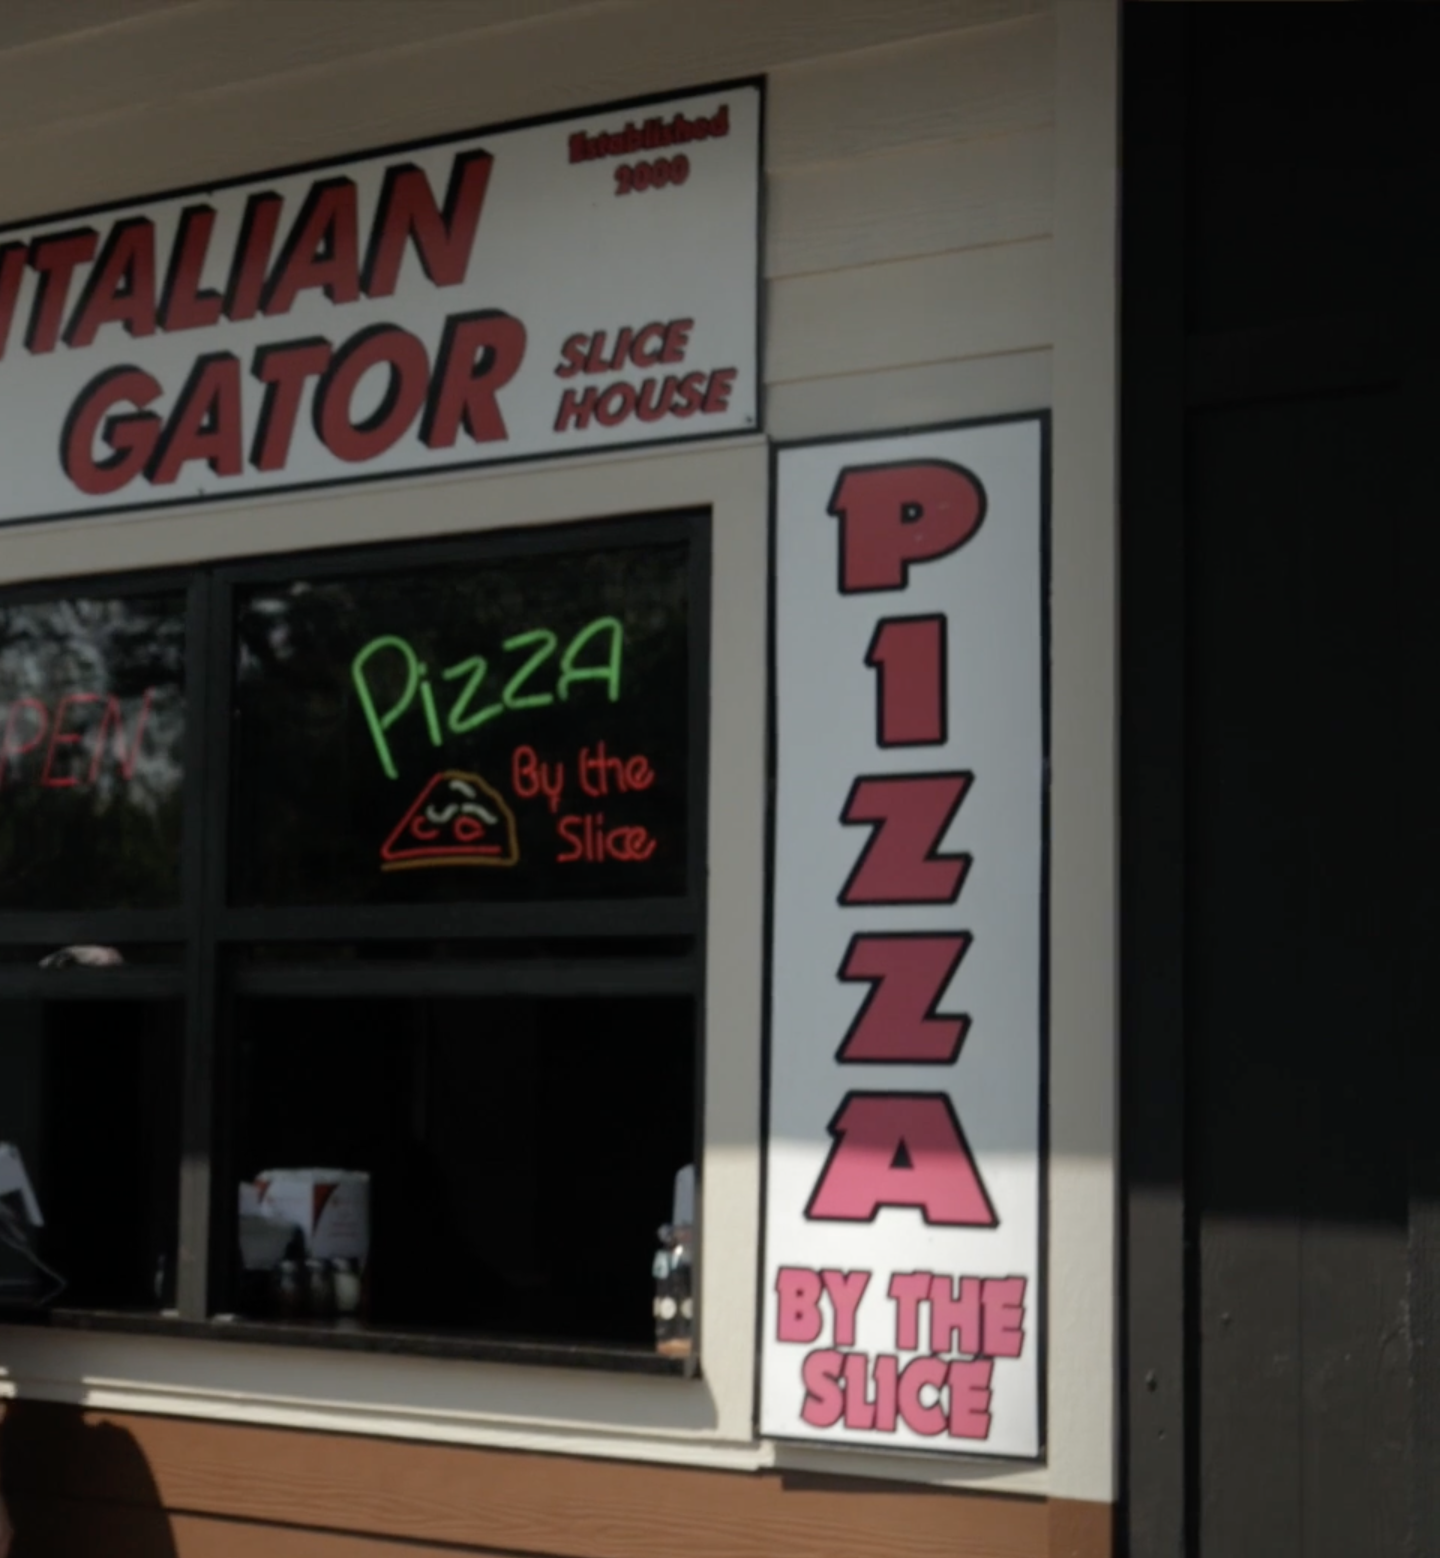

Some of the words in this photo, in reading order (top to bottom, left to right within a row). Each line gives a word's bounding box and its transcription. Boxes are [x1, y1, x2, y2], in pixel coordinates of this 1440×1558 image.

[567, 105, 731, 164] Established
[613, 153, 690, 195] 2000
[554, 318, 694, 379] SLICE
[59, 308, 526, 496] GATOR
[552, 367, 737, 434] HOUSE
[511, 744, 564, 813] By
[580, 742, 655, 796] the
[556, 815, 655, 863] Slice
[803, 457, 1000, 1227] PIZZA
[775, 1266, 871, 1349] BY
[888, 1269, 1027, 1358] THE
[799, 1347, 993, 1440] SLICE
